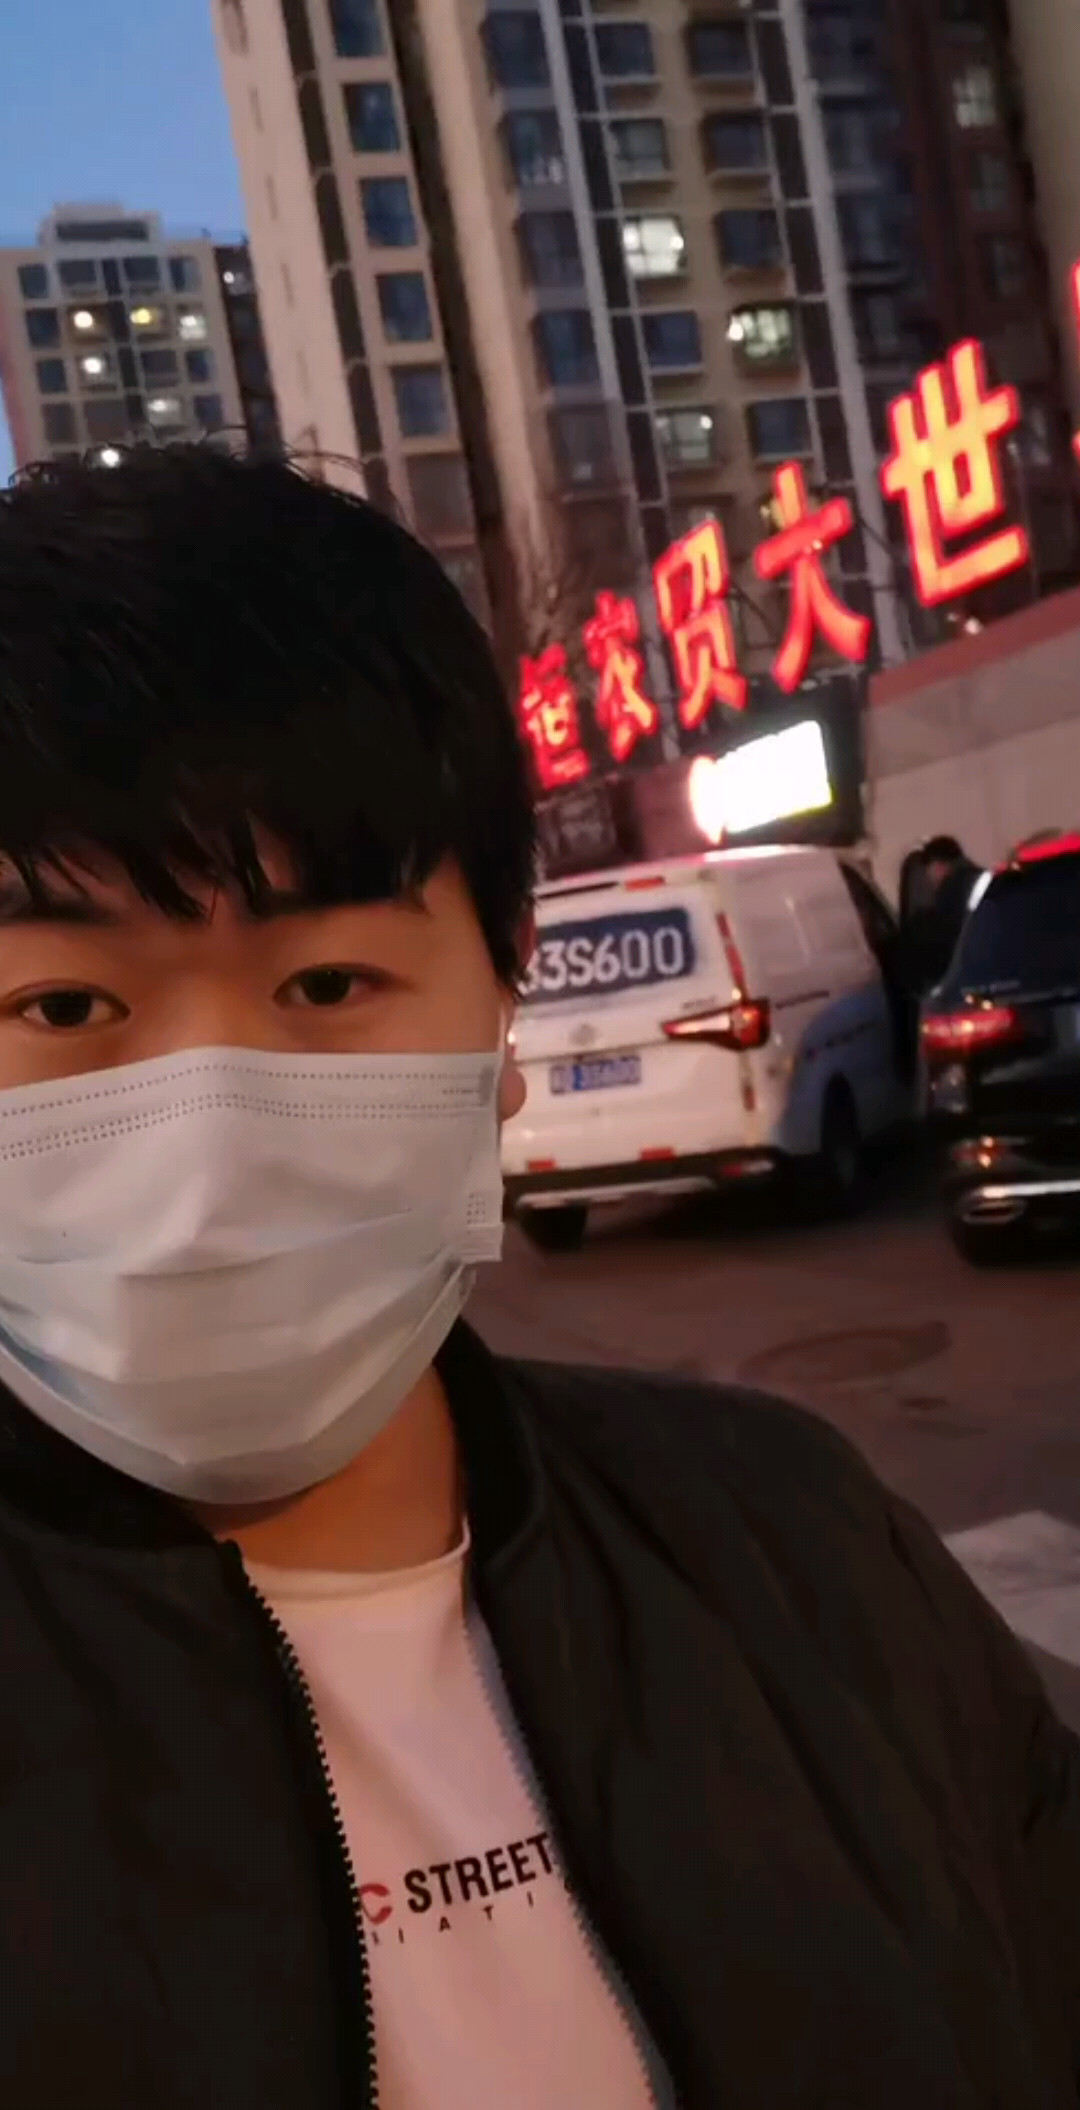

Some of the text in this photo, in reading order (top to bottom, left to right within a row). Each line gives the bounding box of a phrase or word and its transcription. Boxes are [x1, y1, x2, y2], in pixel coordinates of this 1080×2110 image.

[518, 260, 1080, 790] 农贸大世
[403, 1832, 554, 1914] STREET
